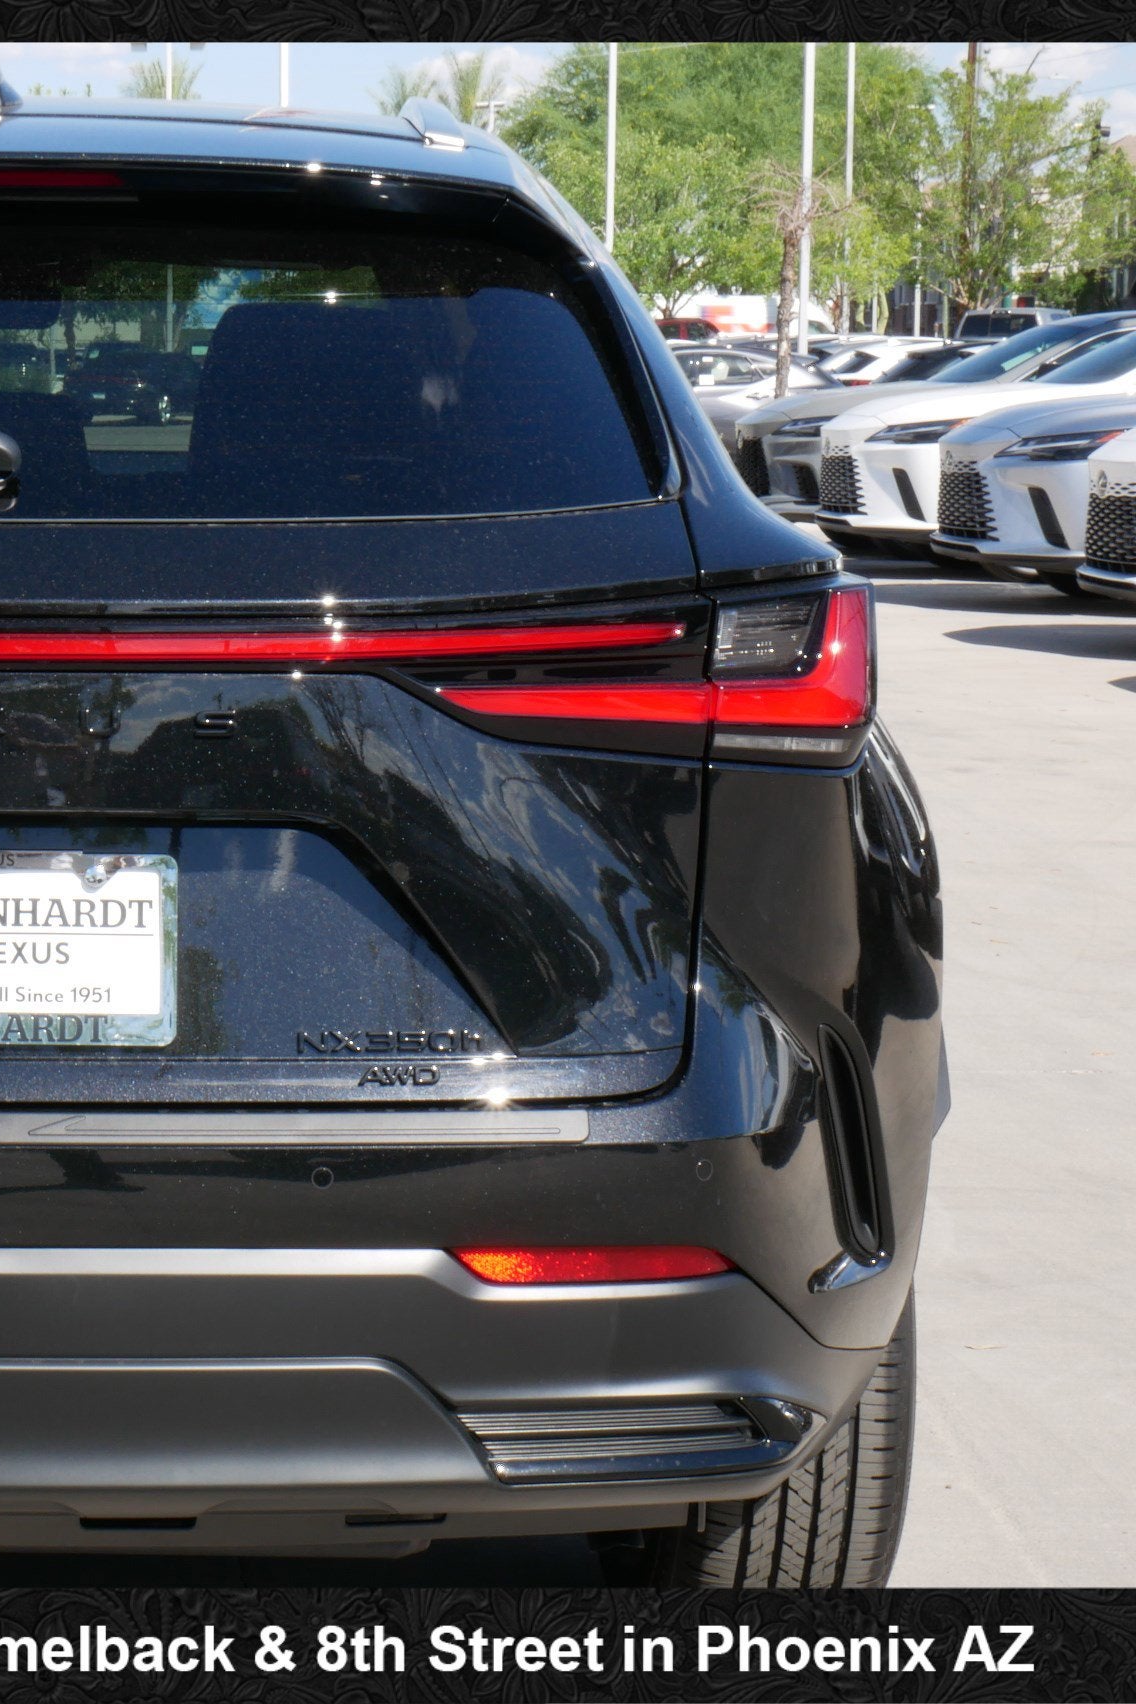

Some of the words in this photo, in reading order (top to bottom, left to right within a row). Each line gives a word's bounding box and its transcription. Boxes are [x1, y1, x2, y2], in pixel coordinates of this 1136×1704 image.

[15, 987, 64, 1003] Since
[71, 987, 112, 1003] 1951
[357, 1065, 441, 1087] AWD
